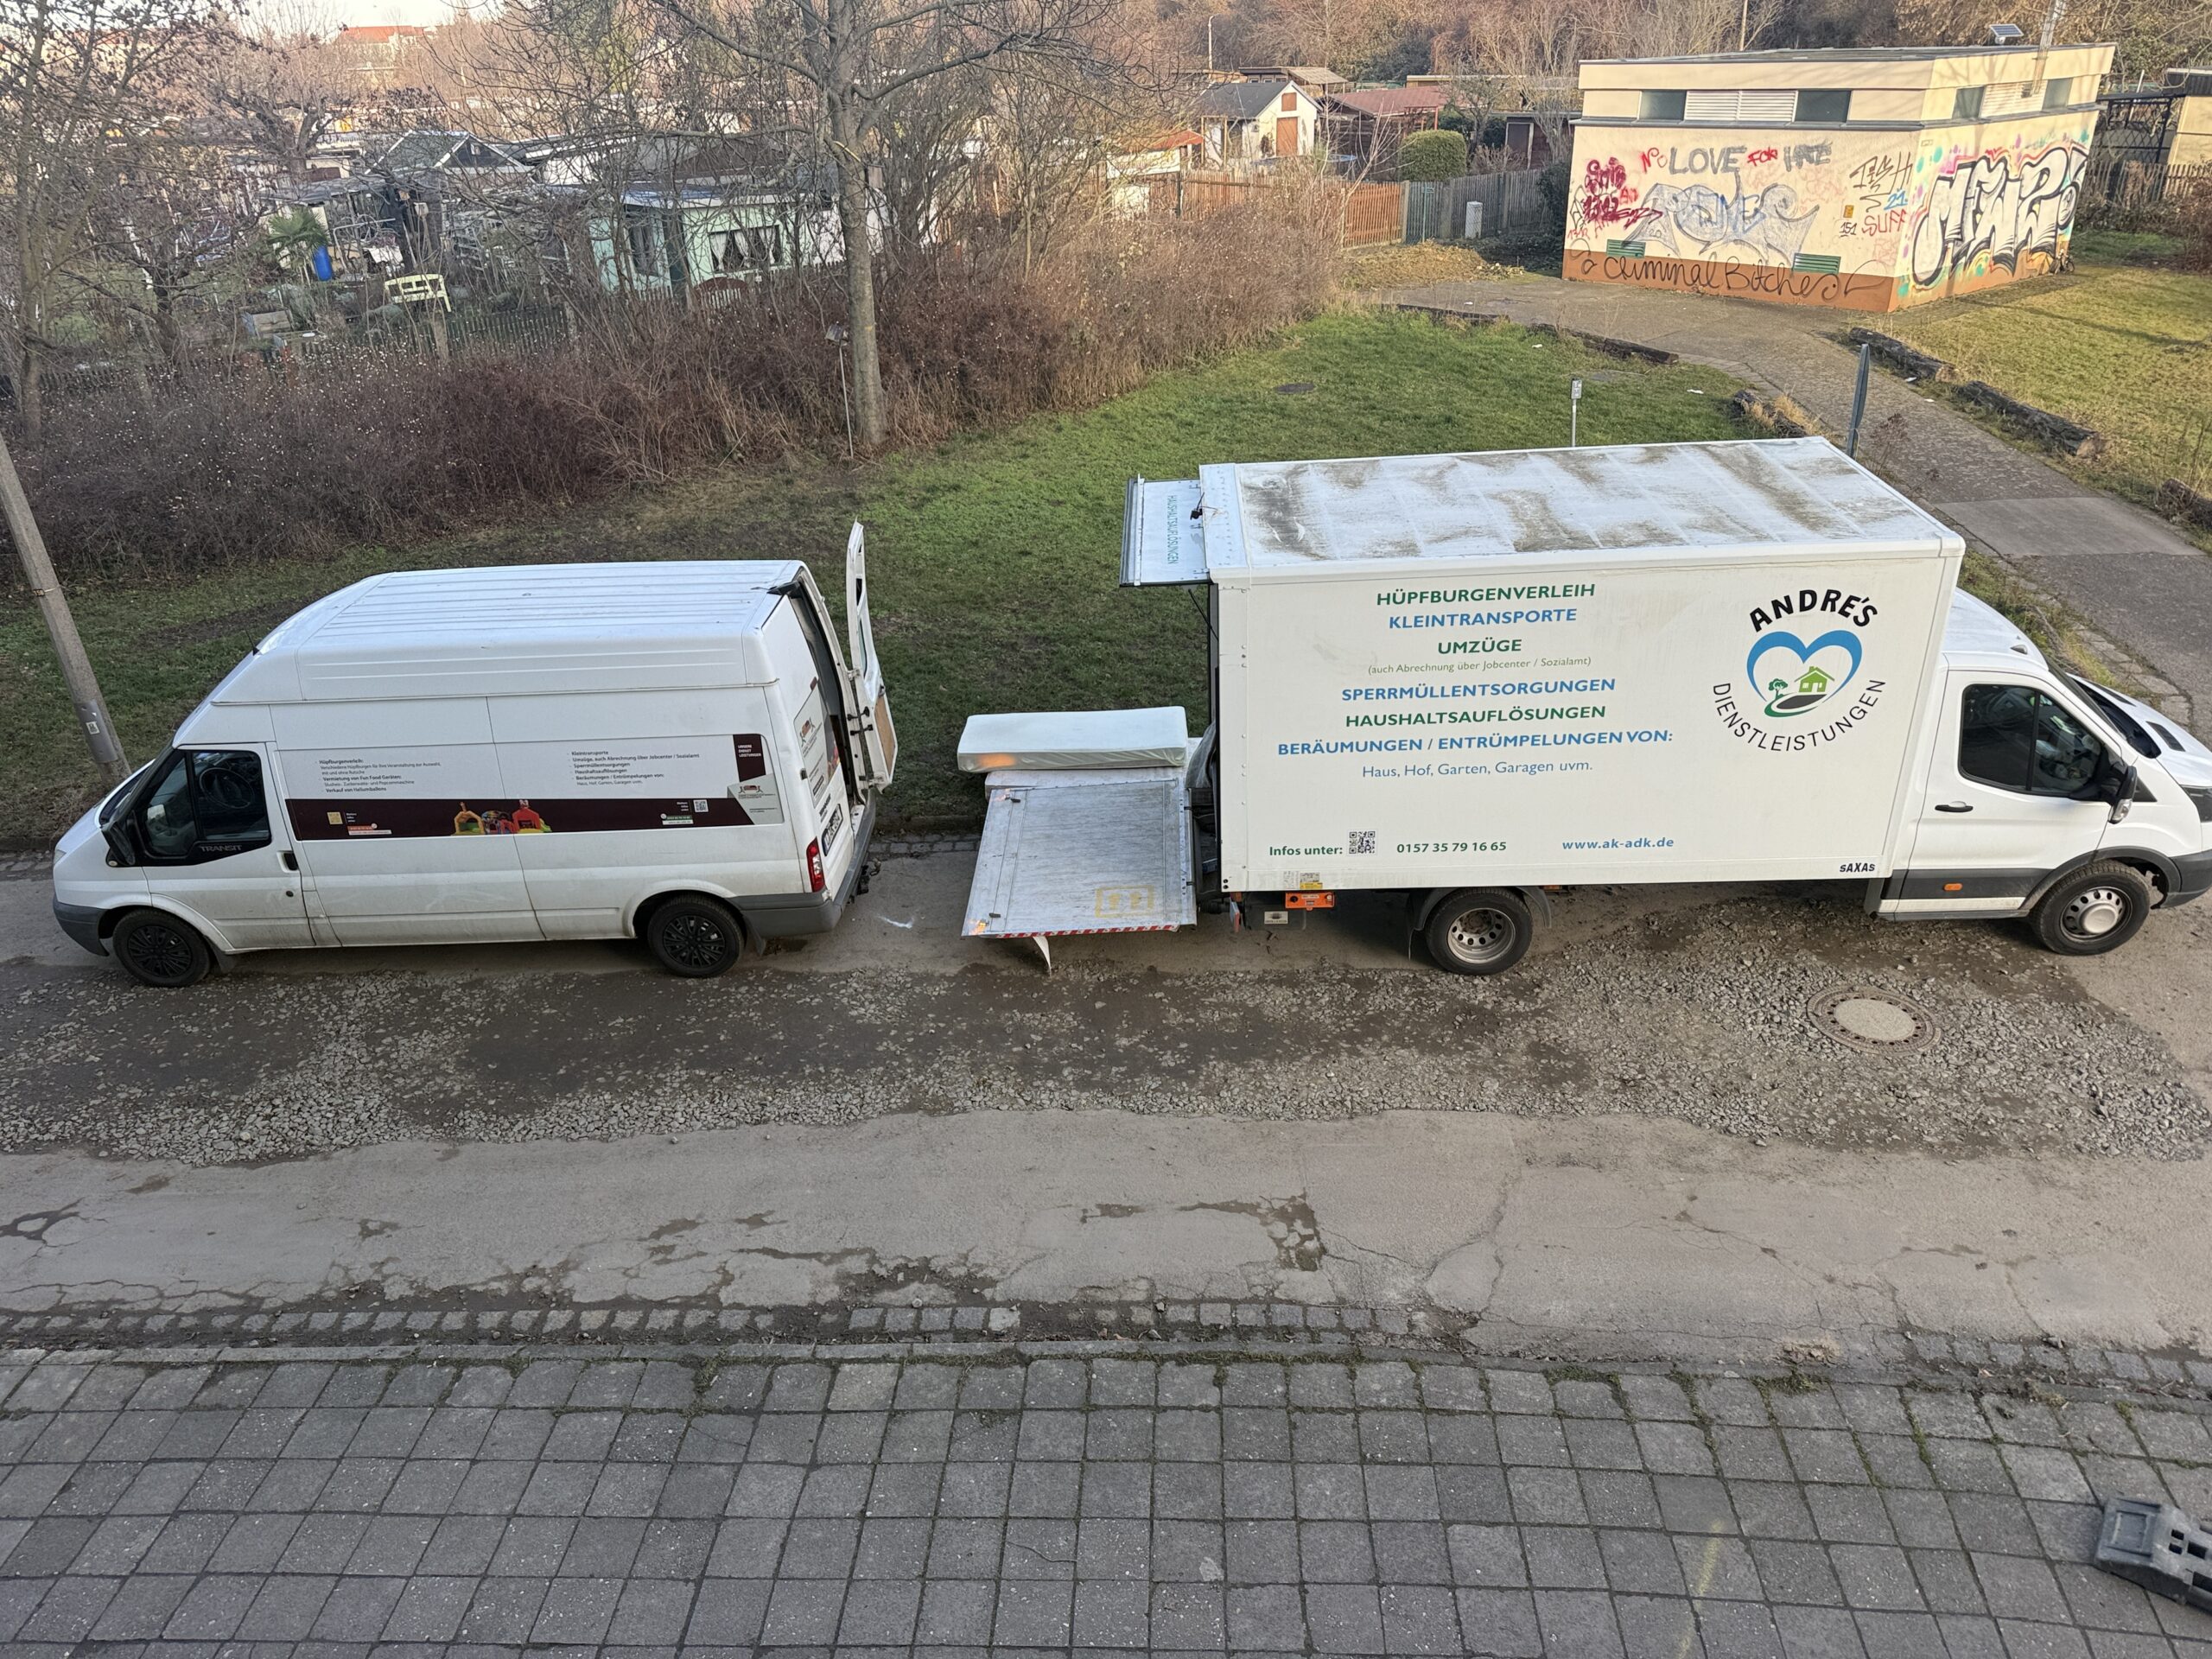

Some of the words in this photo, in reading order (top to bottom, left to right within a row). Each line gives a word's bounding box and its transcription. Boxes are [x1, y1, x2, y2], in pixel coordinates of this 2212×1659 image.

[1669, 145, 1747, 175] LOVE
[1376, 583, 1596, 606] HÜPFBURGENVERLEIH
[1389, 608, 1577, 629] KLEINTRANSPORTE
[1438, 636, 1522, 655] UMZÜGE
[1368, 664, 1395, 676] (auch
[1395, 663, 1455, 673] Abrechnung
[1457, 661, 1481, 671] über
[1482, 659, 1531, 672] Jobcenter
[1541, 656, 1592, 667] Sozialamt)
[1342, 678, 1616, 702] SPERRMÜLLENTSORGUNGEN
[1345, 705, 1606, 728] HAUSHALTSAUFLÖSUNGEN
[1713, 679, 1886, 752] DIENSTLEISTUNGEN
[1278, 739, 1423, 755] BERÄUMUNGEN
[1427, 738, 1433, 751] /
[1438, 731, 1624, 750] ENTRÜMPELUNGEN
[1626, 729, 1673, 743] VON:
[1362, 766, 1401, 778] Haus,
[1404, 763, 1433, 777] Hof,
[1437, 763, 1491, 775] Garten,
[1495, 761, 1554, 776] Garagen
[1559, 762, 1593, 772] uvm.
[1269, 845, 1301, 856] Infos
[1304, 846, 1343, 855] unter:
[1561, 836, 1675, 850] www.ak-adk.de
